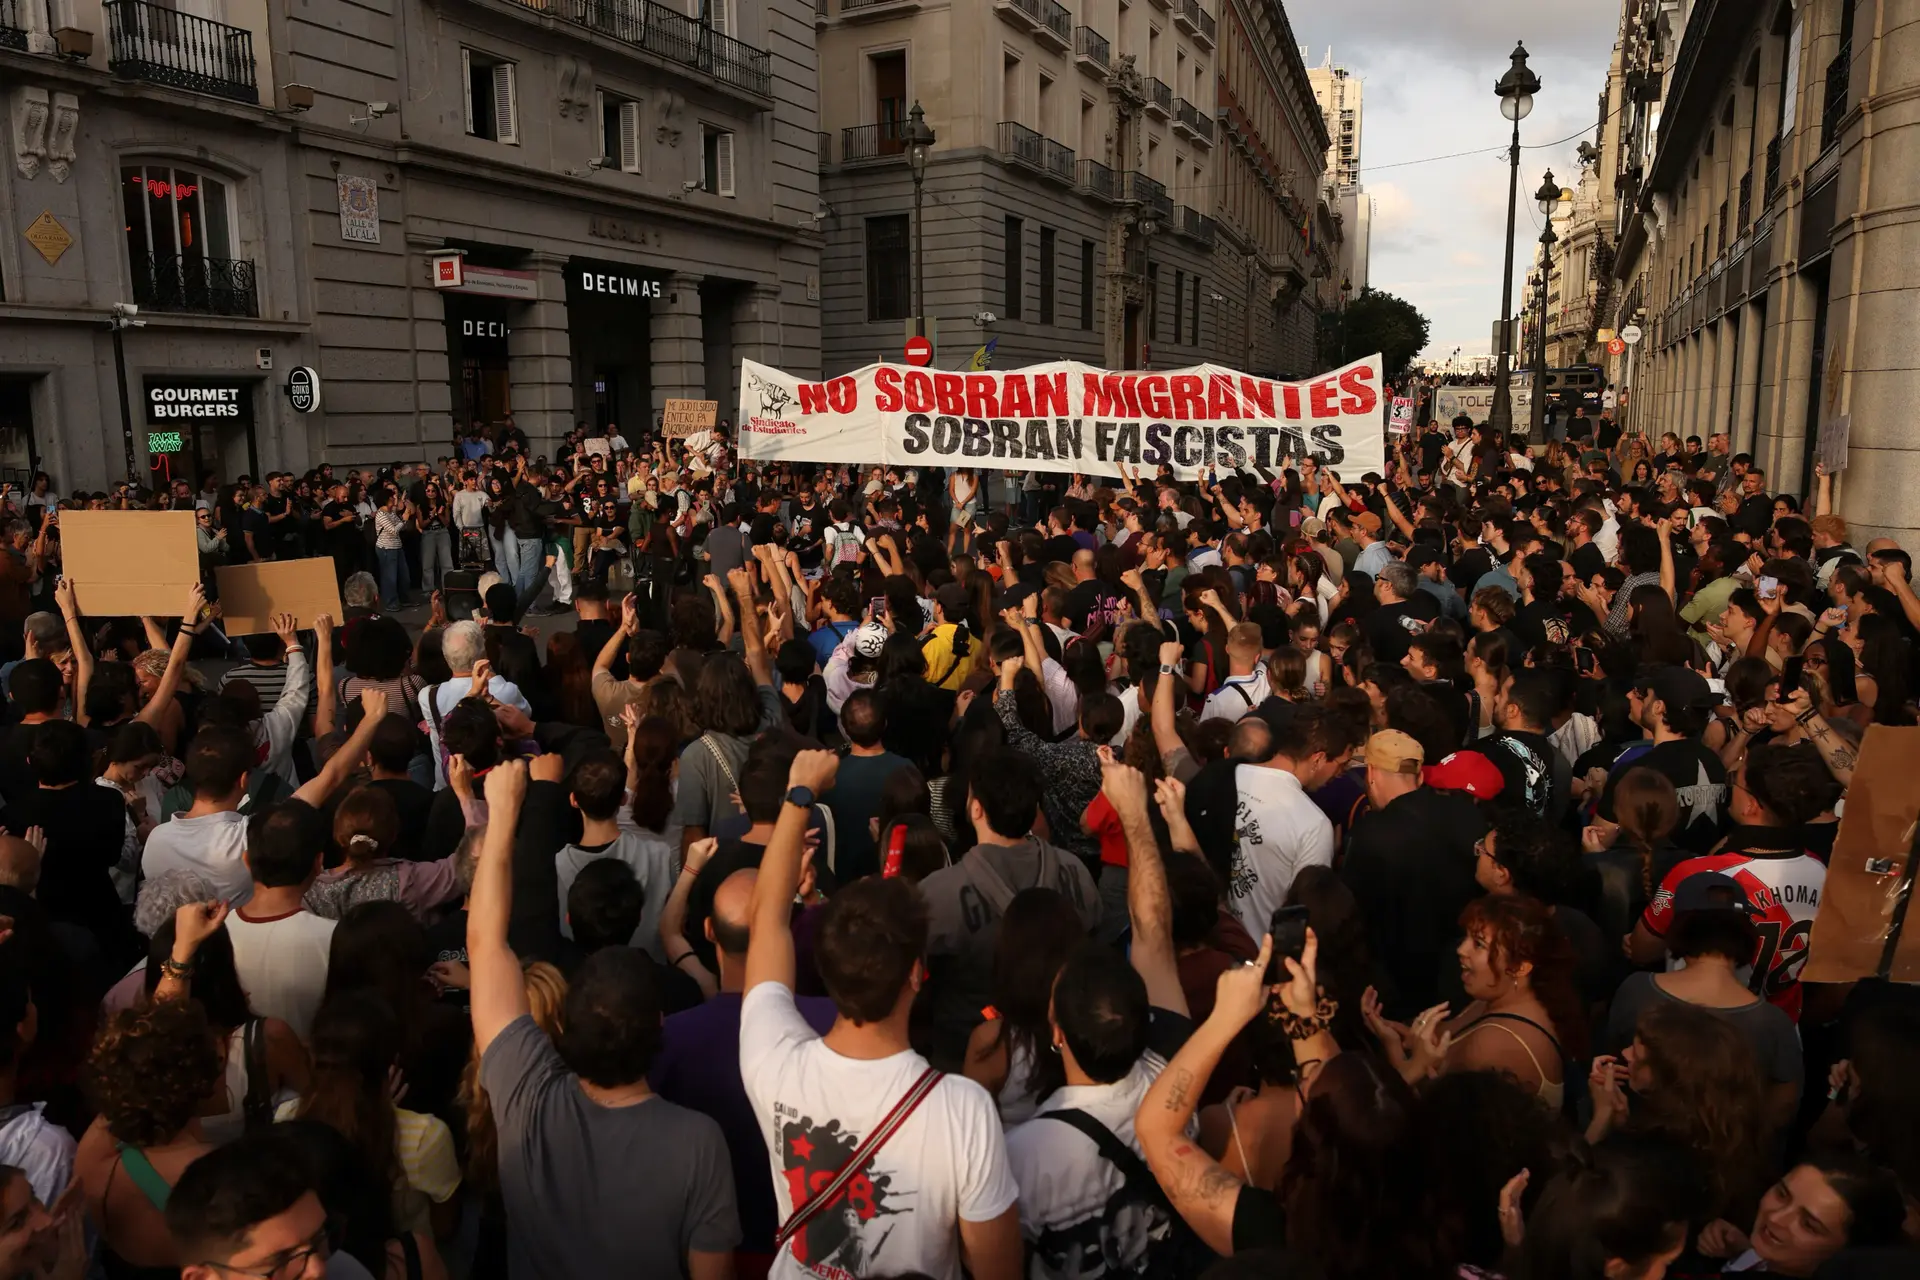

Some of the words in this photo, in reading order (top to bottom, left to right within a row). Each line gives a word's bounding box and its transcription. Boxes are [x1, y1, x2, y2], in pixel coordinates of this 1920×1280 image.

[346, 219, 366, 228] CALLE
[582, 272, 661, 298] DECIMAS
[463, 320, 511, 338] DECI
[150, 388, 239, 401] GOURMET
[291, 385, 310, 395] GOIKO
[797, 375, 858, 415] NO
[874, 367, 1070, 418] SOBRAN
[1082, 365, 1378, 420] MIGRANTES
[1394, 398, 1413, 407] ANTI
[1516, 394, 1532, 406] S.
[154, 404, 239, 417] BURGERS
[666, 412, 695, 423] ENTERO
[697, 412, 707, 423] PA
[750, 416, 797, 428] Sindicato
[742, 423, 752, 432] de
[752, 424, 808, 435] Estudiantes
[903, 413, 1083, 460] SOBRAN
[1095, 421, 1345, 468] FASCISTAS
[1755, 885, 1821, 909] KHOMA
[1748, 920, 1811, 996] 12
[774, 1101, 798, 1119] SALUD
